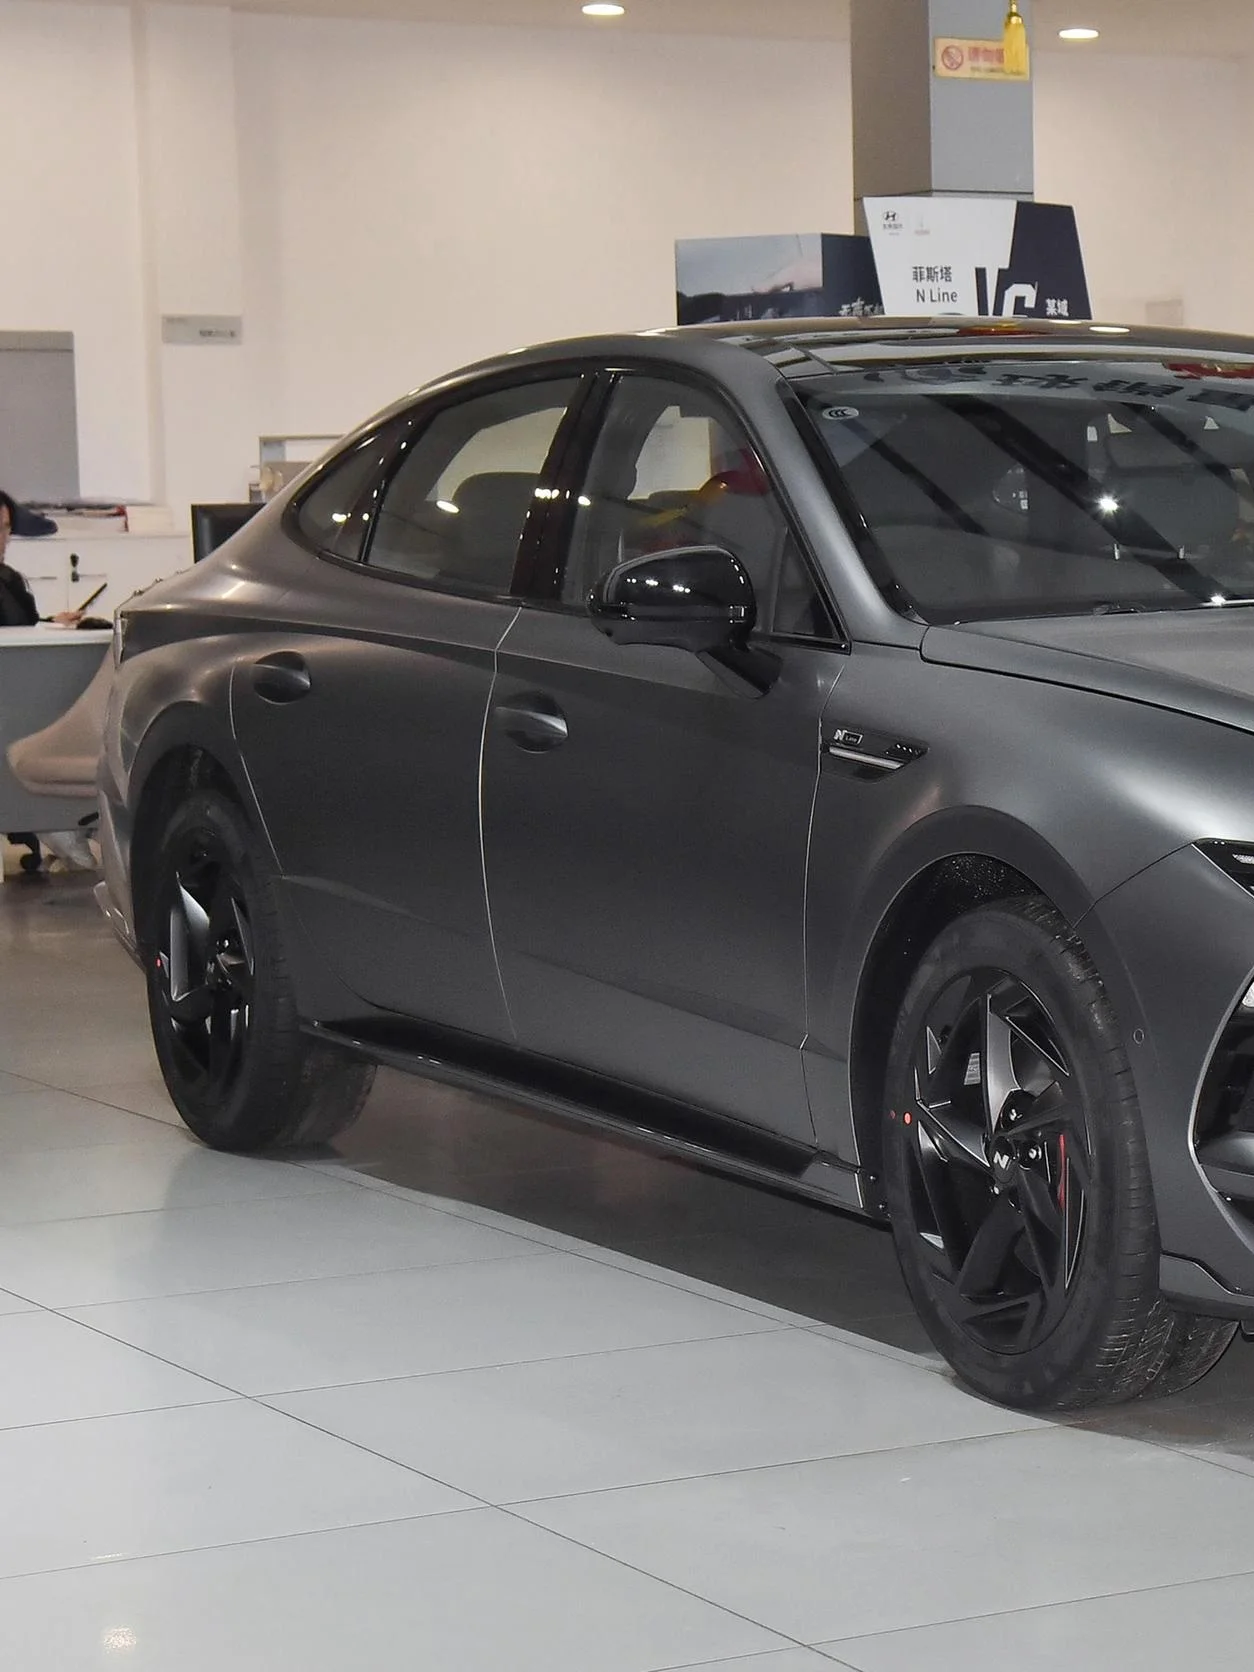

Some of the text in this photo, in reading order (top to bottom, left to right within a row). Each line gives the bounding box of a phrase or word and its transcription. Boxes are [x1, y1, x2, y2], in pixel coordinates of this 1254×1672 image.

[912, 266, 953, 283] 菲斯塔
[916, 288, 958, 303] N Line
